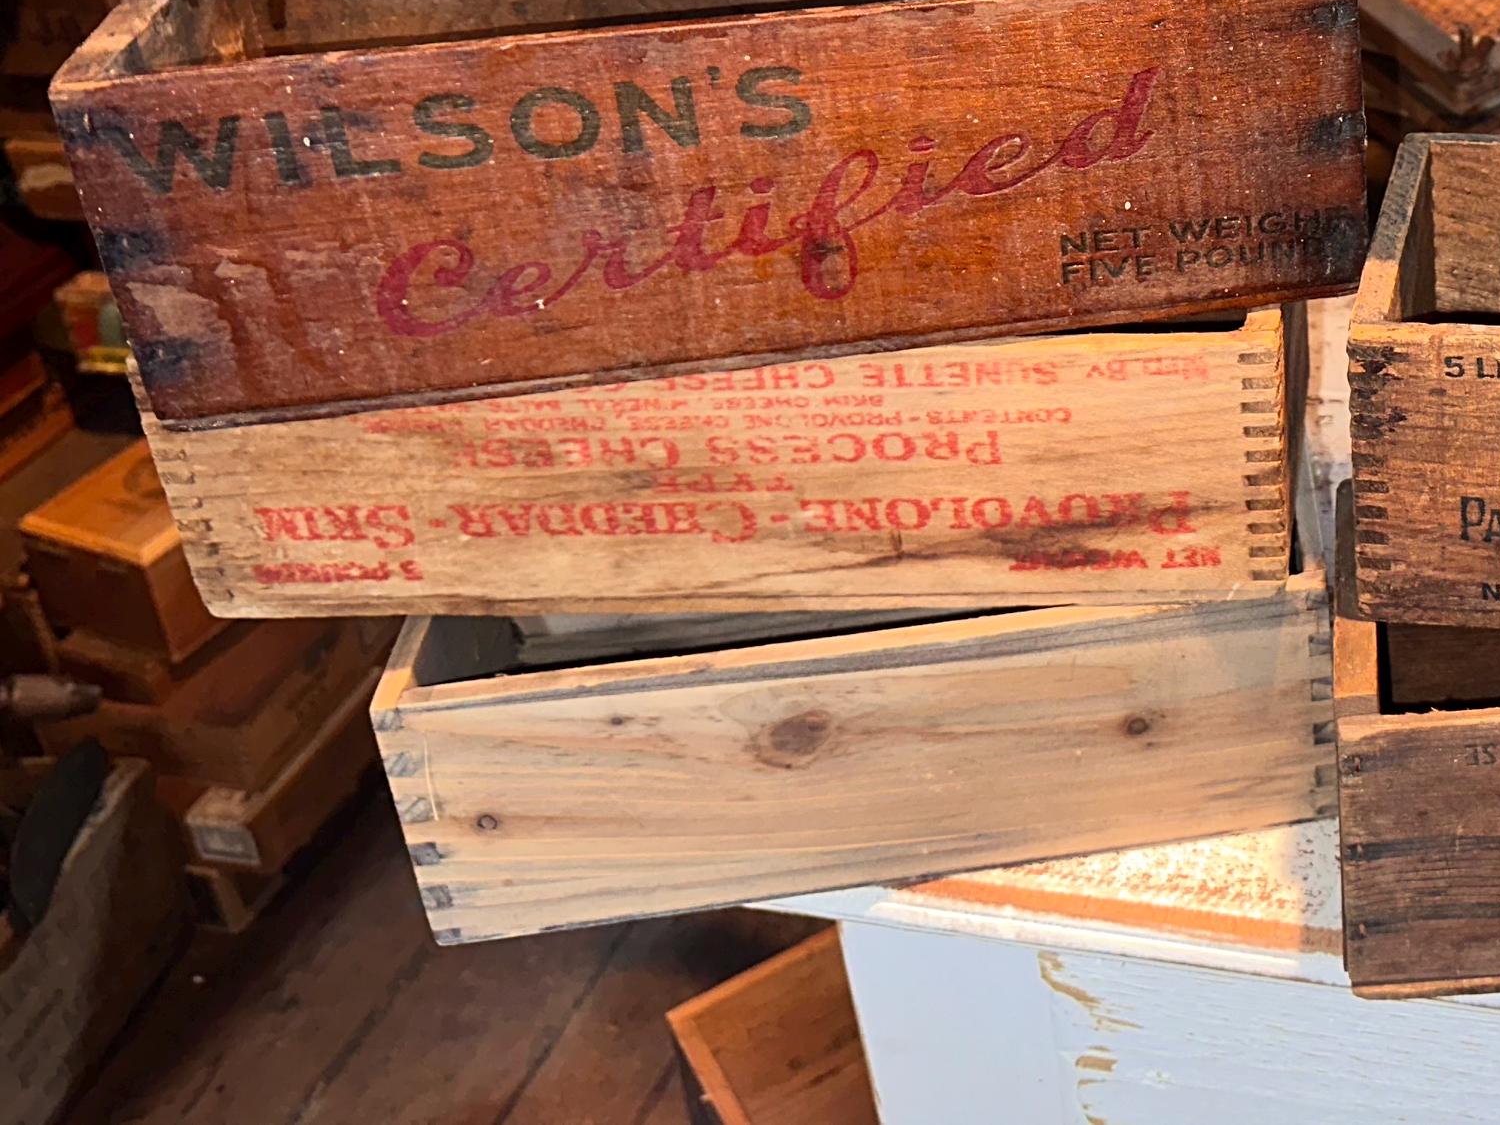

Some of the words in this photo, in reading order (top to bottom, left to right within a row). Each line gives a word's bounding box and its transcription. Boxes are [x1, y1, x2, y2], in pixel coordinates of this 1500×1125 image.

[98, 65, 811, 192] WILSON'S
[376, 65, 1160, 336] Certified
[1060, 226, 1149, 257] NET
[1169, 208, 1348, 244] WEIGHT
[1062, 255, 1156, 285] FIVE
[860, 361, 1058, 388] SUNETTE
[1444, 356, 1465, 378] 5
[704, 430, 1002, 465] PROCESS
[653, 473, 794, 494] TYPE
[253, 504, 415, 550] SKIM
[400, 561, 422, 580] 5
[1161, 547, 1221, 569] NET
